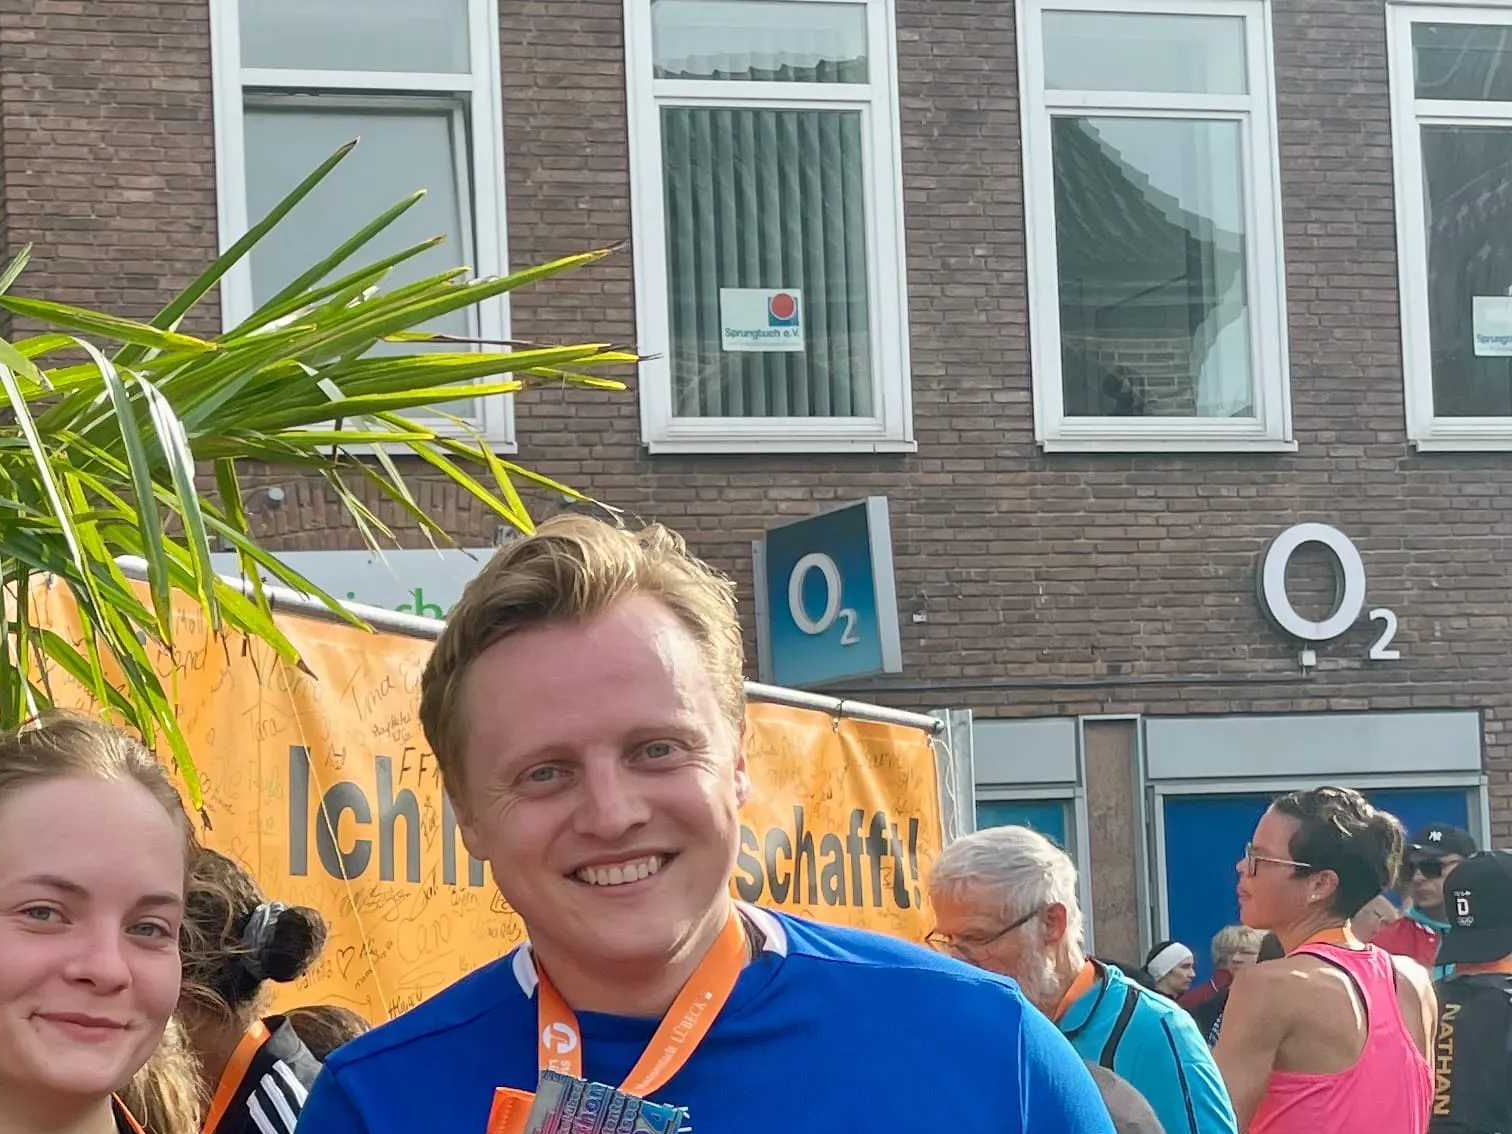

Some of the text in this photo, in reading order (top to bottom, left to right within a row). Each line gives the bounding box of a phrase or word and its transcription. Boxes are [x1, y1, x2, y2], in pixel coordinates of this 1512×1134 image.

[289, 745, 421, 883] Ich
[736, 805, 921, 910] schafft!
[1433, 1003, 1461, 1115] NATHAN
